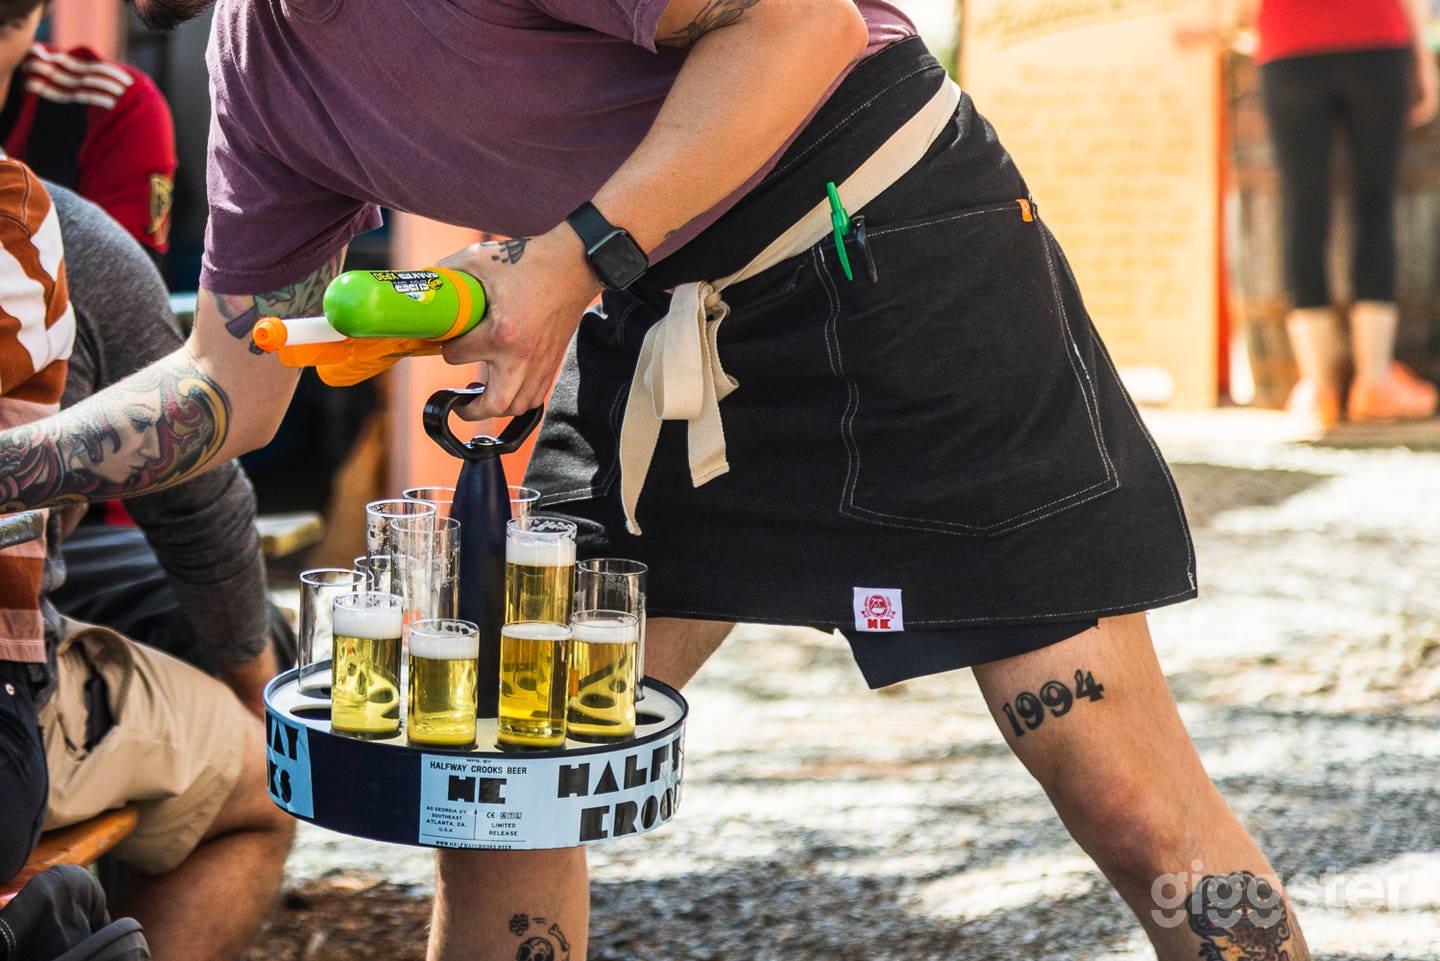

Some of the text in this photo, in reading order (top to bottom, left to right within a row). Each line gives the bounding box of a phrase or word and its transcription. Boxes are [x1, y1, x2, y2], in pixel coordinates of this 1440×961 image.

[1002, 669, 1104, 737] 1994
[430, 761, 528, 775] HALFWAY CROOKS BEER
